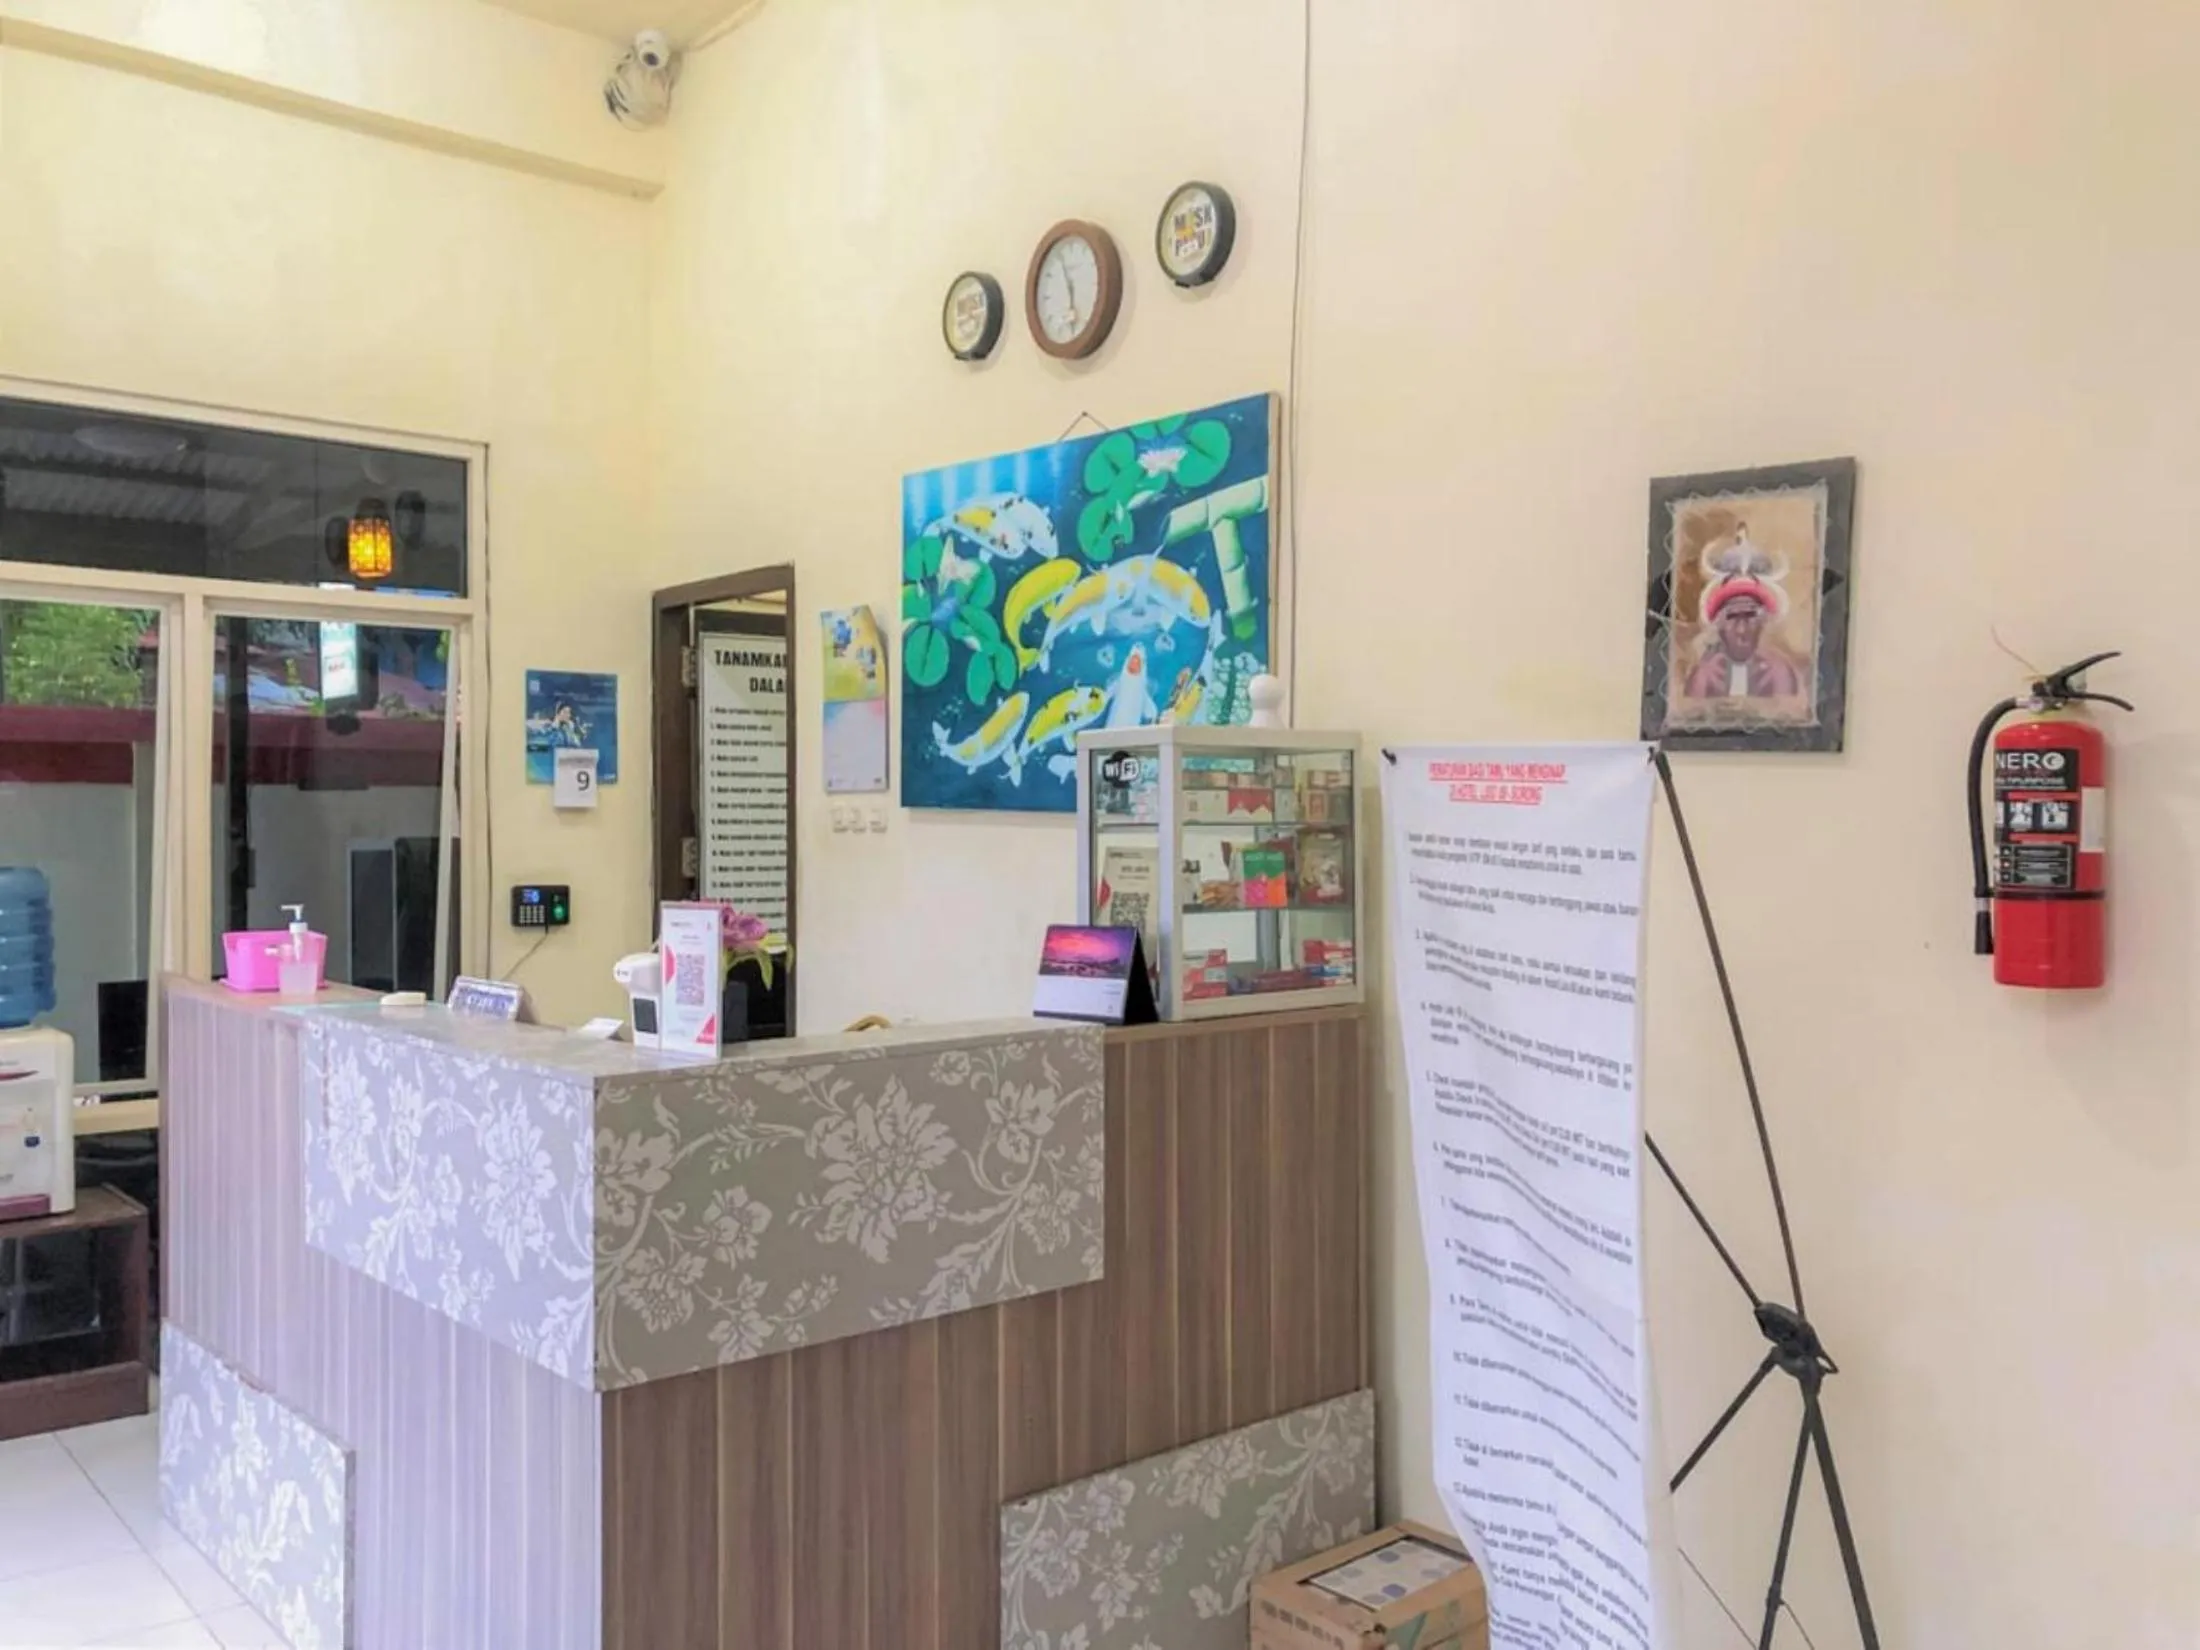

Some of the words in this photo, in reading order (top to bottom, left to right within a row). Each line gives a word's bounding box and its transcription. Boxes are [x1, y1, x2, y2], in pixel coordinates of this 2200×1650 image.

[714, 650, 787, 668] TANAMKA
[749, 677, 787, 693] DALA
[576, 771, 590, 791] 9
